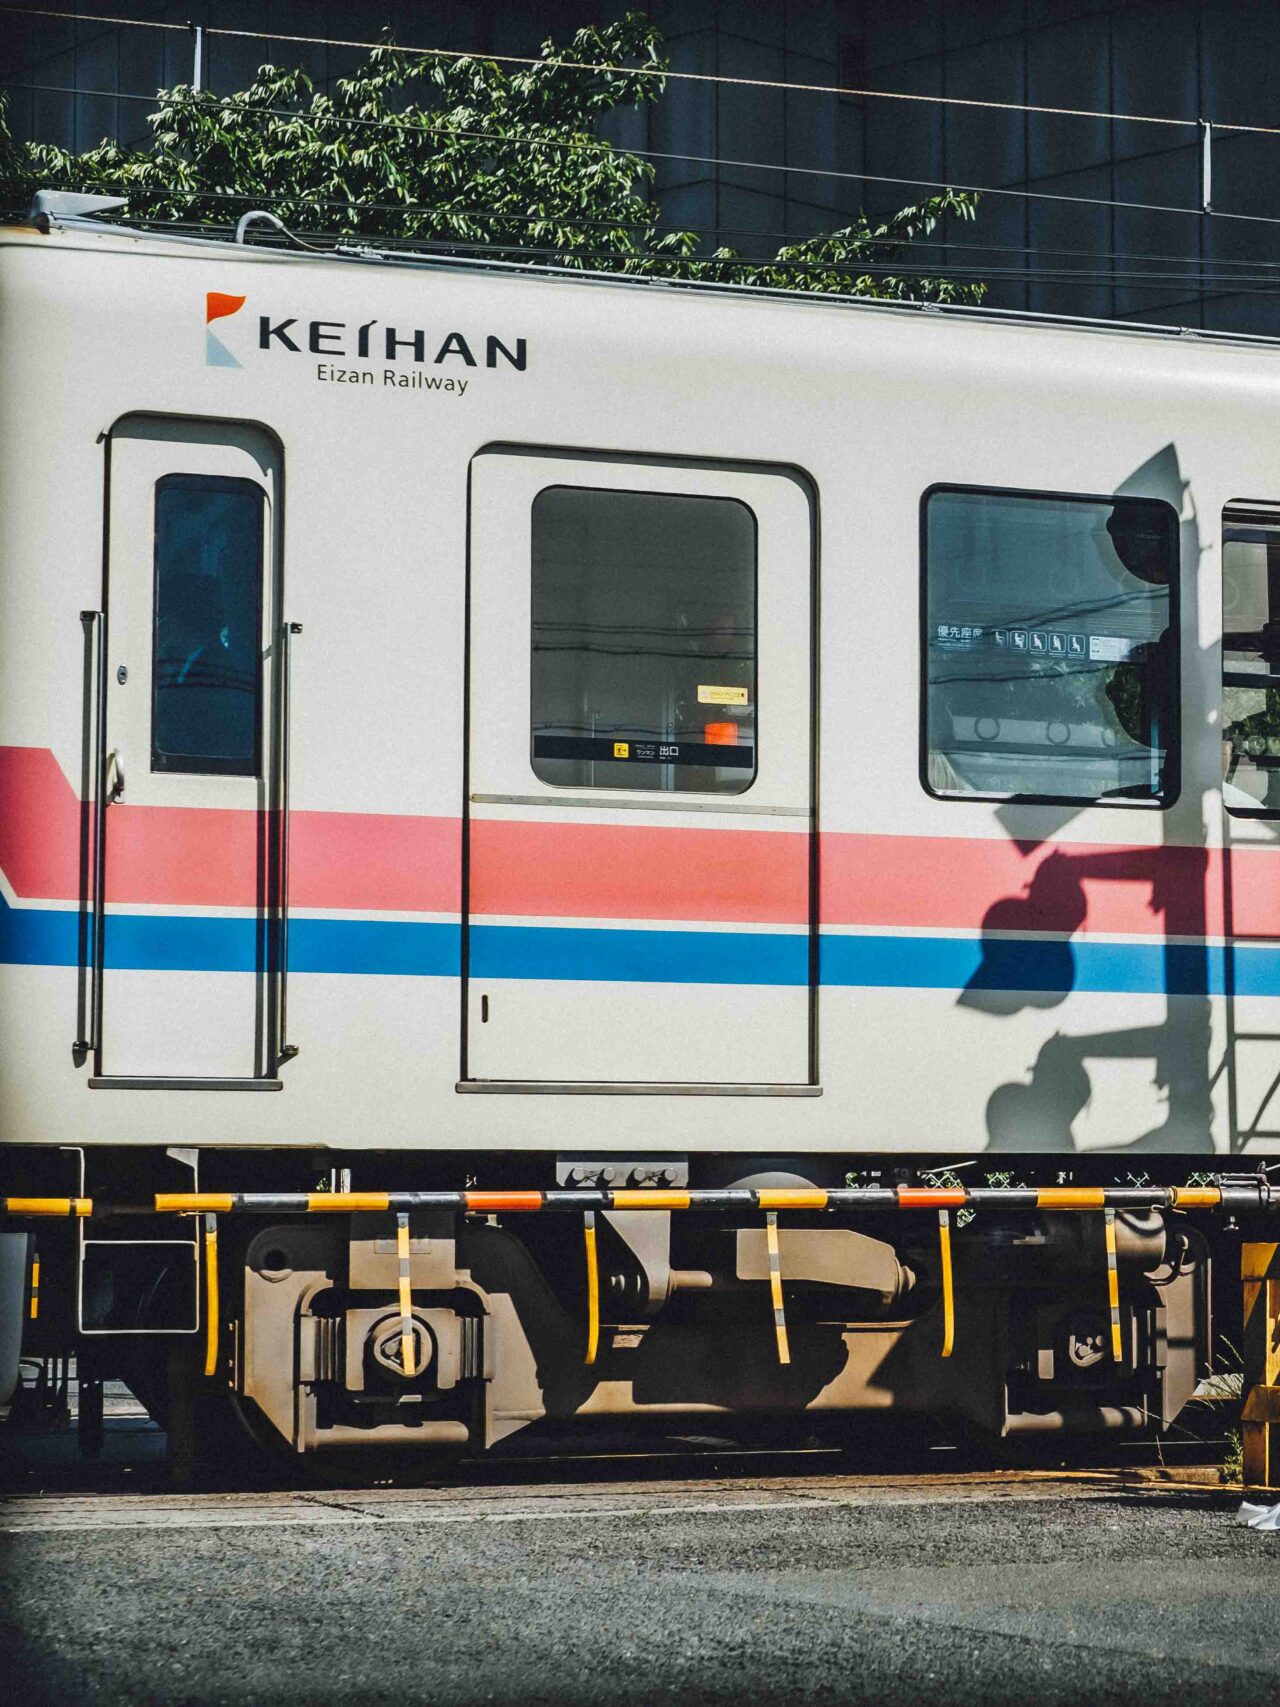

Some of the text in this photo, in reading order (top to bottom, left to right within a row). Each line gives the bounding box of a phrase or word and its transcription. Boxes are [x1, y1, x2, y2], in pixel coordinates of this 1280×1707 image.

[259, 316, 527, 371] KEIHAN
[317, 364, 469, 396] Eizan Railway
[659, 746, 679, 756] 出口
